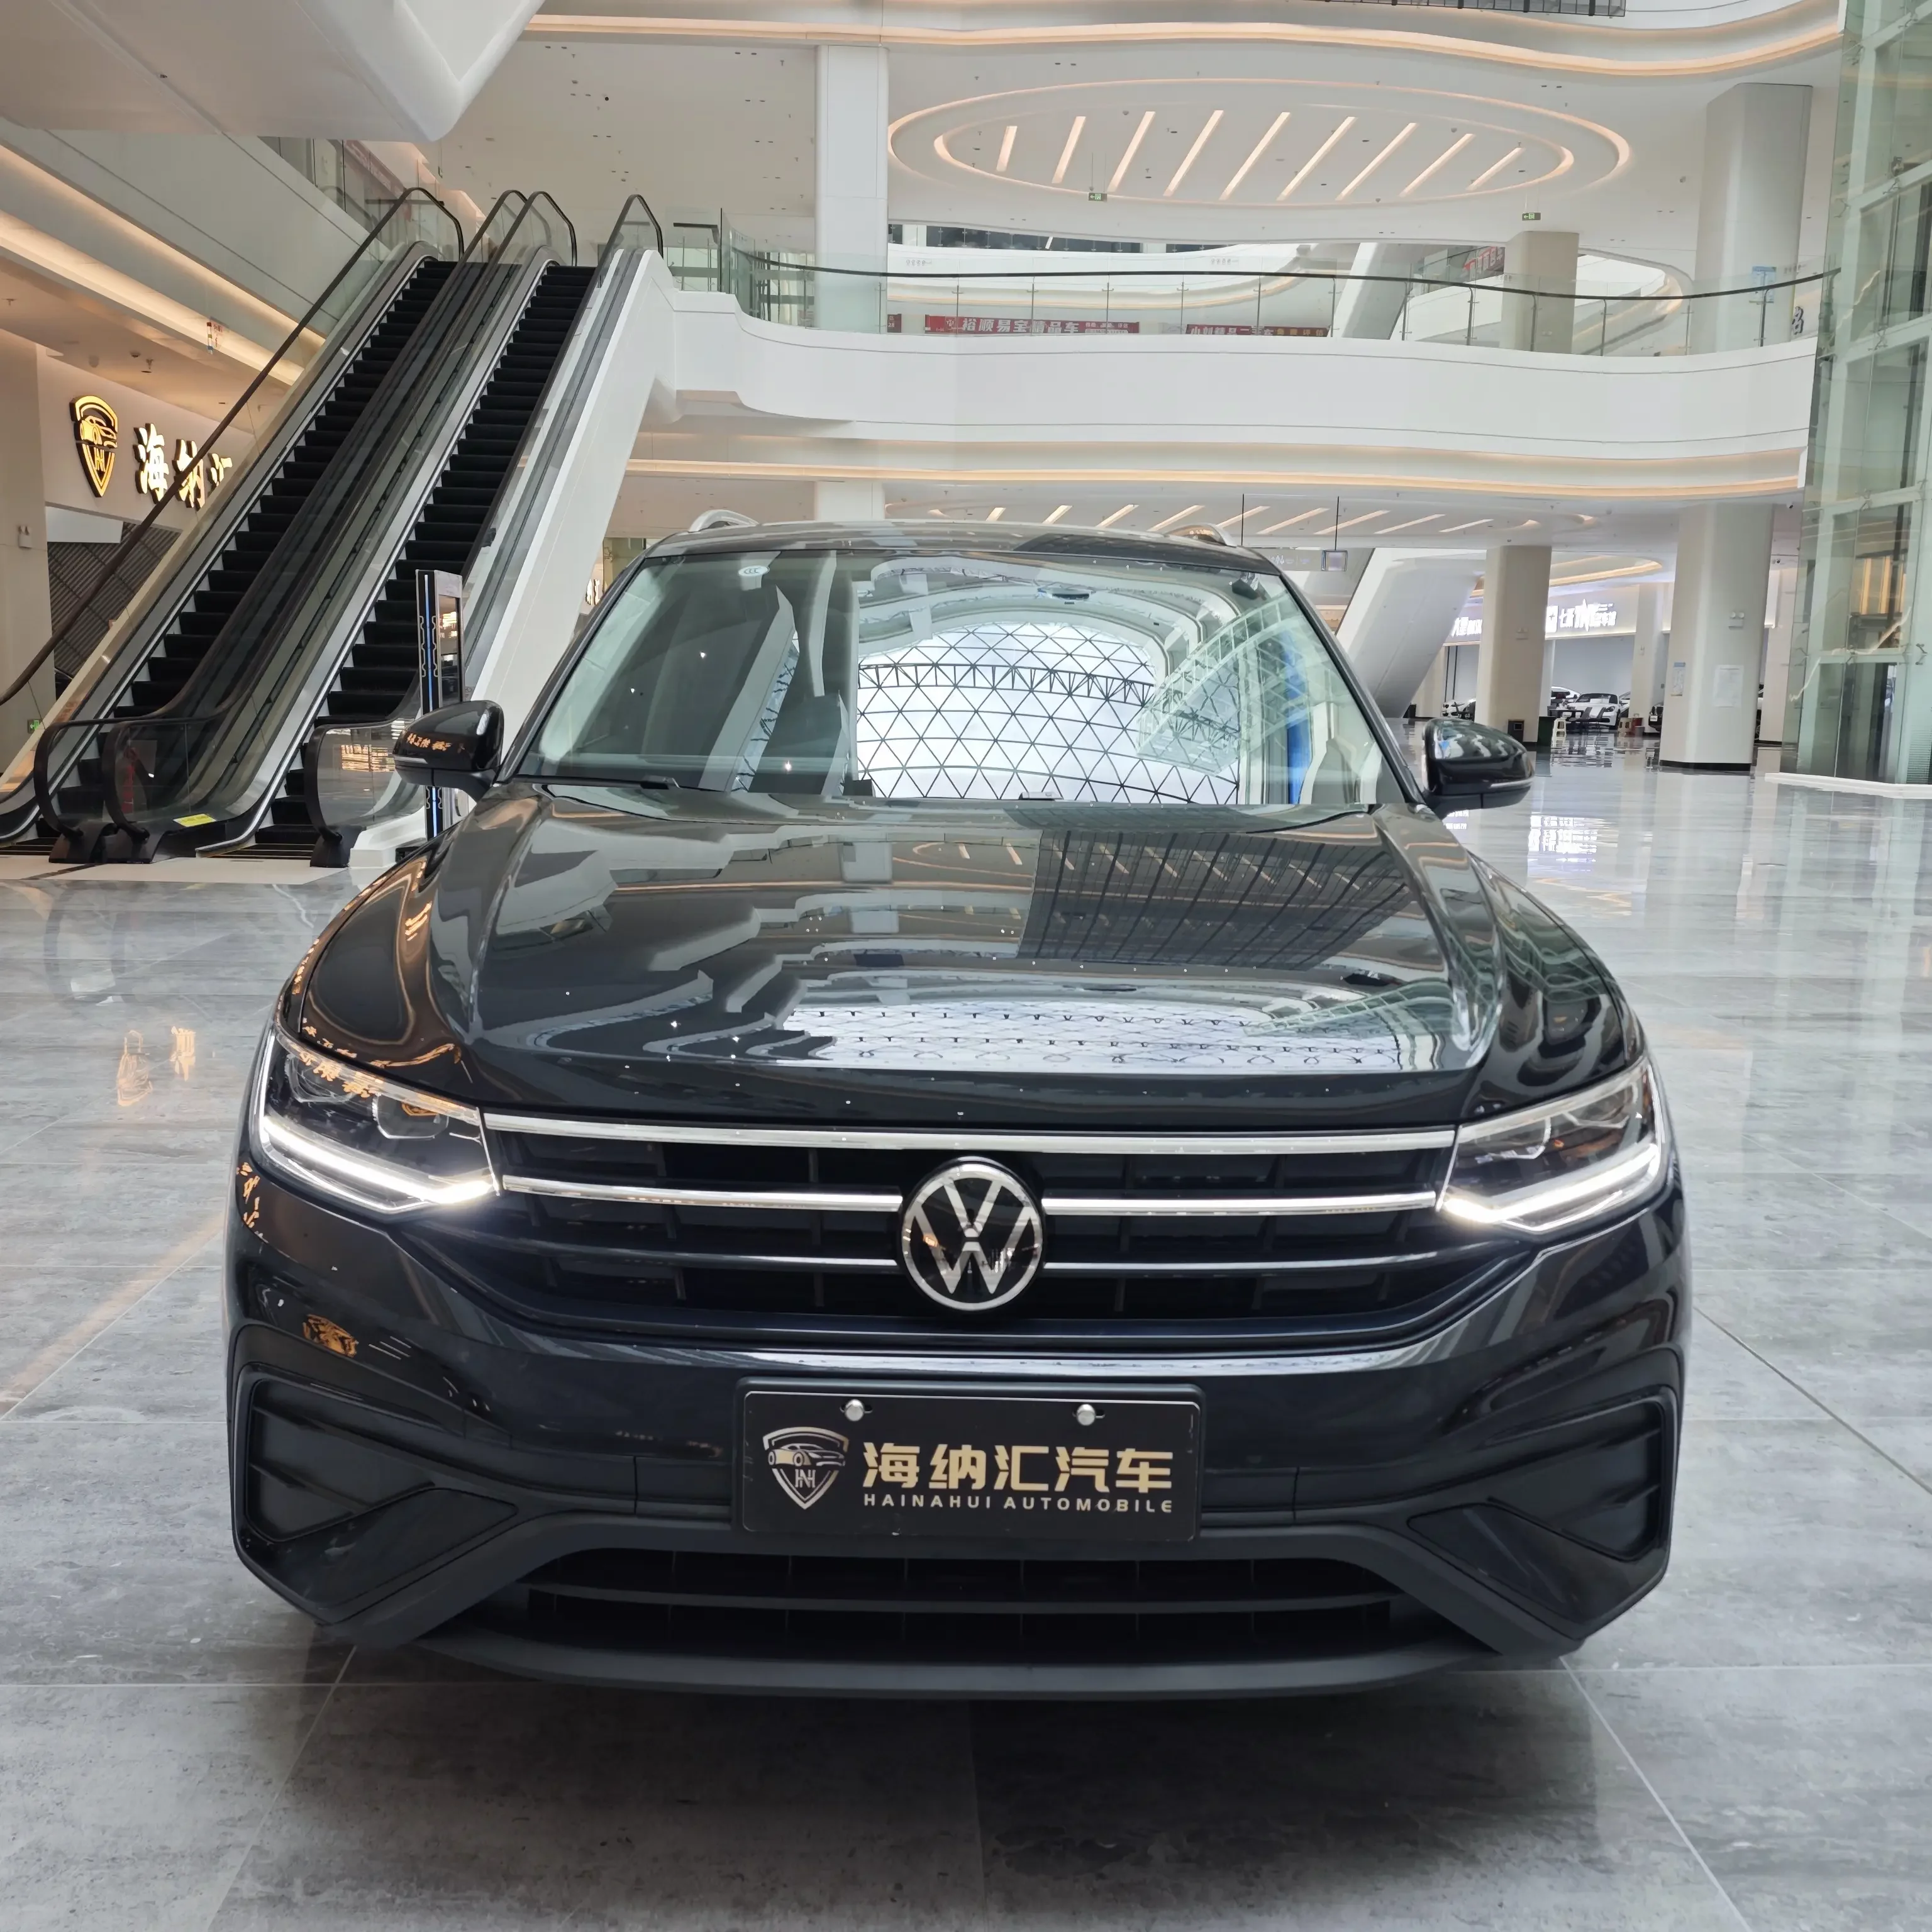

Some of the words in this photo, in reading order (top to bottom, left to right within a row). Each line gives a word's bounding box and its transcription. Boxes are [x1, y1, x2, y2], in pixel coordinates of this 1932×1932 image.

[863, 1441, 1174, 1494] 海纳汇汽车
[864, 1493, 991, 1509] HAINAHUI
[1004, 1497, 1172, 1513] AUTOMOBILE
